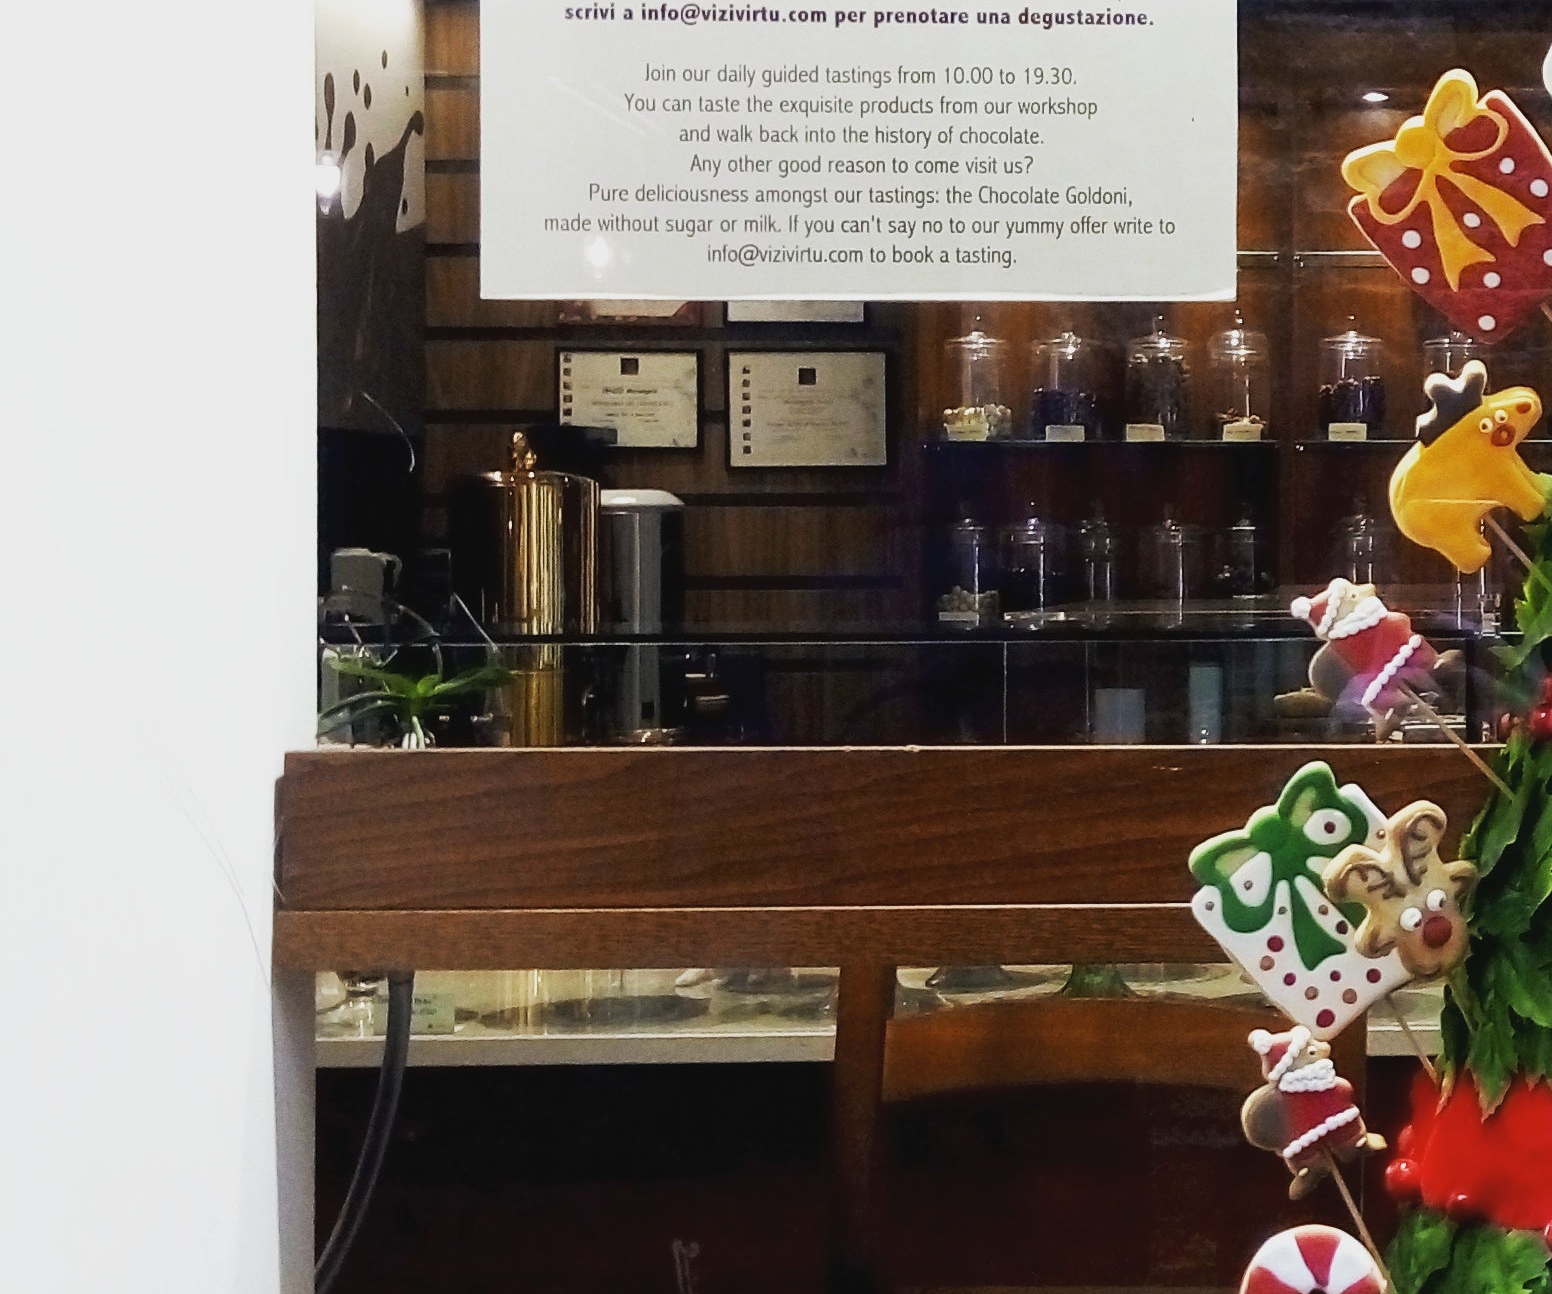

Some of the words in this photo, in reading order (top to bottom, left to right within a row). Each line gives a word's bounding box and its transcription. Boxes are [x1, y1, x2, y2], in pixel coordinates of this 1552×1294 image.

[564, 2, 615, 21] scrivi
[622, 8, 634, 21] a
[641, 3, 827, 27] info@vizivirtu.com
[834, 10, 867, 29] per
[873, 7, 969, 30] prenotare
[976, 11, 1011, 26] una
[1017, 7, 1154, 32] degustazione.
[645, 62, 676, 82] Join
[682, 68, 712, 82] our
[717, 63, 756, 88] daily
[761, 63, 819, 88] guided
[825, 65, 892, 89] tastings
[897, 65, 936, 84] from
[944, 65, 994, 85] 10.00
[999, 68, 1016, 85] to
[1024, 66, 1077, 85] 19.30.
[624, 92, 656, 112] You
[662, 98, 692, 112] can
[698, 96, 740, 114] taste
[746, 94, 773, 113] the
[779, 95, 854, 118] exquisite
[860, 95, 934, 120] products
[939, 95, 978, 115] from
[984, 101, 1013, 115] our
[1017, 96, 1098, 120] workshop
[679, 123, 711, 143] and
[716, 124, 753, 143] walk
[759, 124, 799, 143] back
[805, 125, 836, 144] into
[842, 125, 869, 144] the
[875, 126, 932, 150] history
[937, 125, 954, 144] of
[959, 126, 1044, 146] chocolate.
[690, 153, 722, 177] Any
[727, 154, 773, 173] other
[778, 154, 822, 179] good
[828, 159, 886, 174] reason
[891, 158, 909, 175] to
[914, 160, 960, 174] come
[965, 154, 998, 174] visit
[1003, 155, 1034, 175] us?
[589, 182, 629, 202] Pure
[634, 183, 749, 203] deliciousness
[755, 186, 829, 208] amongst
[834, 189, 863, 204] our
[868, 185, 940, 210] tastings:
[945, 185, 973, 204] the
[978, 185, 1060, 205] Chocolate
[1065, 186, 1133, 208] Goldoni,
[544, 212, 592, 232] made
[597, 213, 659, 233] without
[665, 218, 713, 238] sugar
[719, 219, 738, 233] or
[744, 214, 782, 233] milk.
[788, 214, 799, 233] If
[804, 219, 835, 239] you
[887, 220, 917, 239] say
[922, 220, 943, 234] no
[948, 217, 966, 234] to
[971, 220, 1001, 235] our
[1005, 220, 1065, 240] yummy
[1069, 215, 1109, 236] offer
[1113, 216, 1154, 235] write
[1159, 219, 1176, 236] to
[707, 243, 864, 268] info@vizivirtu.com
[869, 247, 887, 264] to
[892, 245, 935, 264] book
[939, 249, 950, 264] a
[955, 245, 1017, 269] tasting.
